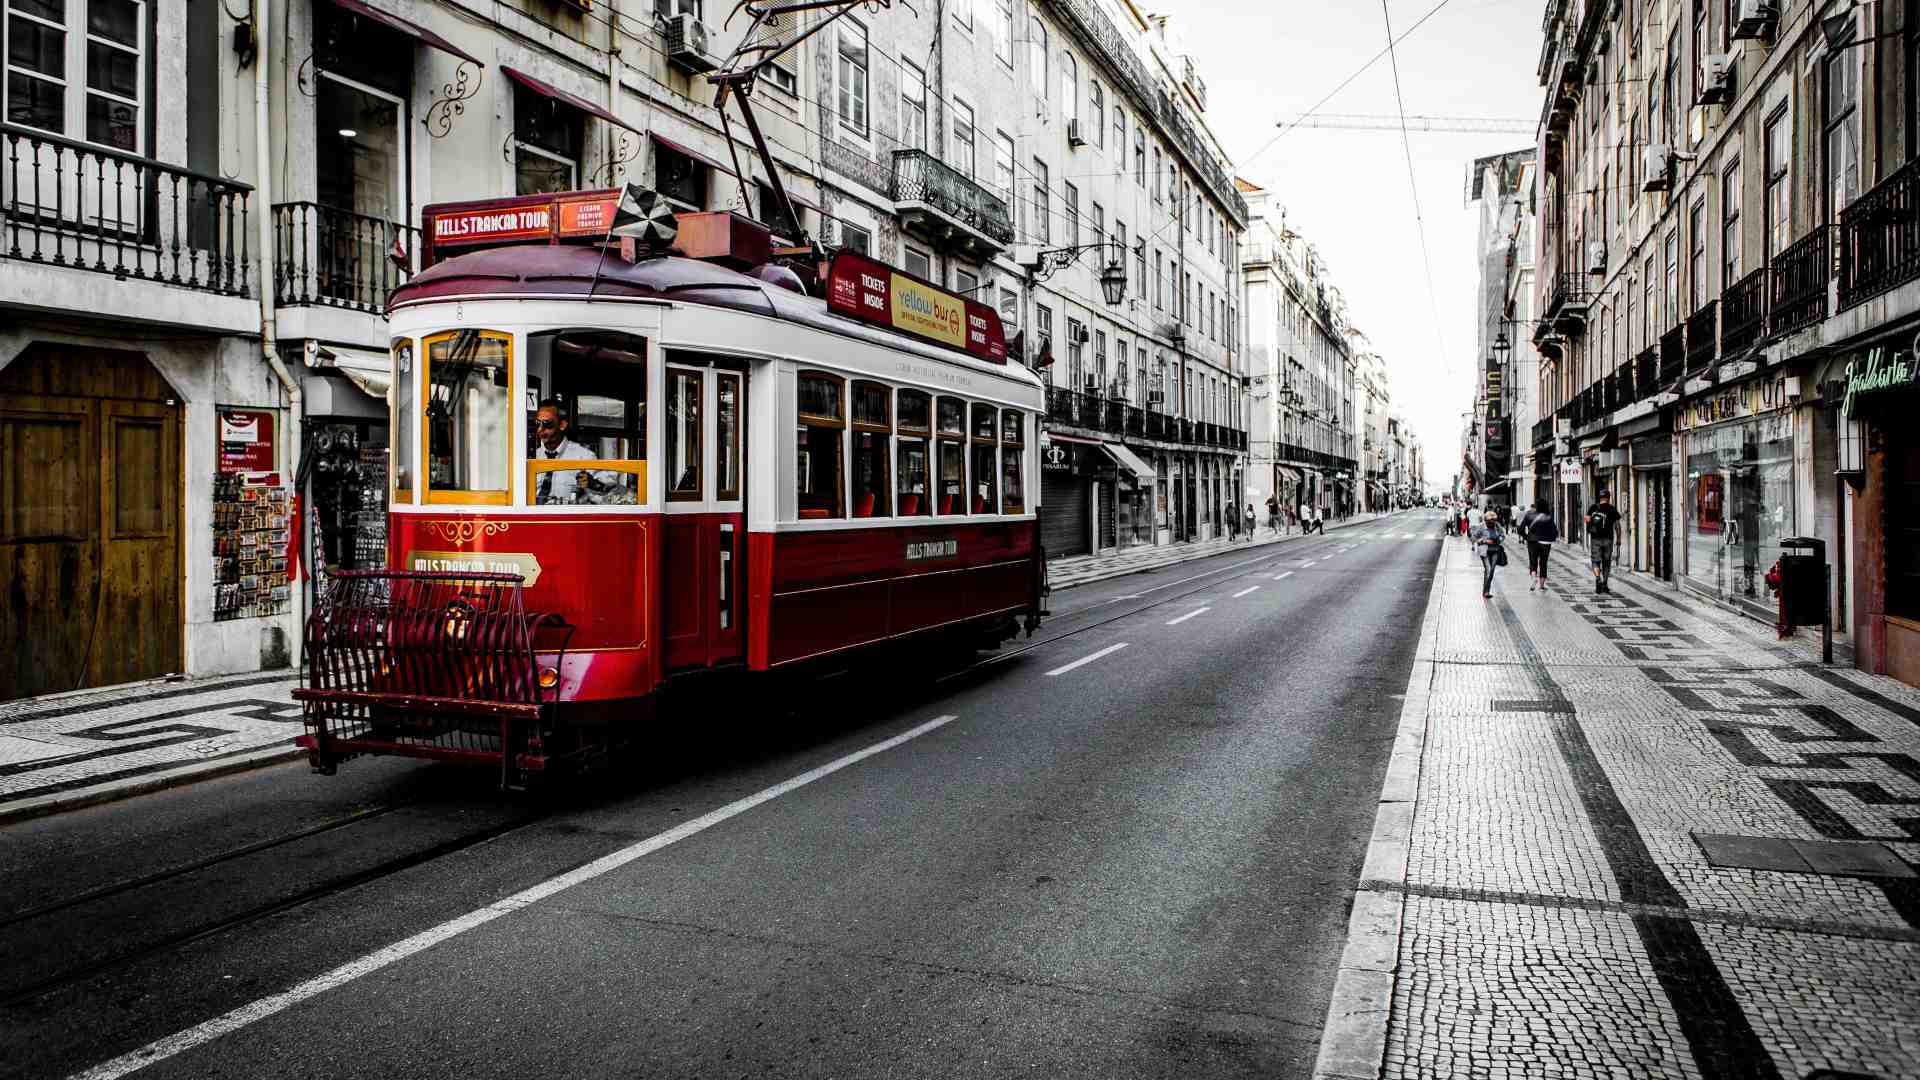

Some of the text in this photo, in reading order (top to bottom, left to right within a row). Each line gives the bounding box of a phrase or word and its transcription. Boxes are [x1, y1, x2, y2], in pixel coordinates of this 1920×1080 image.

[435, 218, 469, 236] HILLS
[518, 210, 549, 229] TOUR
[861, 273, 885, 293] TICKETS
[864, 292, 884, 311] INSIDE
[934, 297, 949, 321] bus
[970, 315, 987, 330] TICKETS
[971, 330, 986, 345] INSIDE
[907, 544, 923, 560] HILLS
